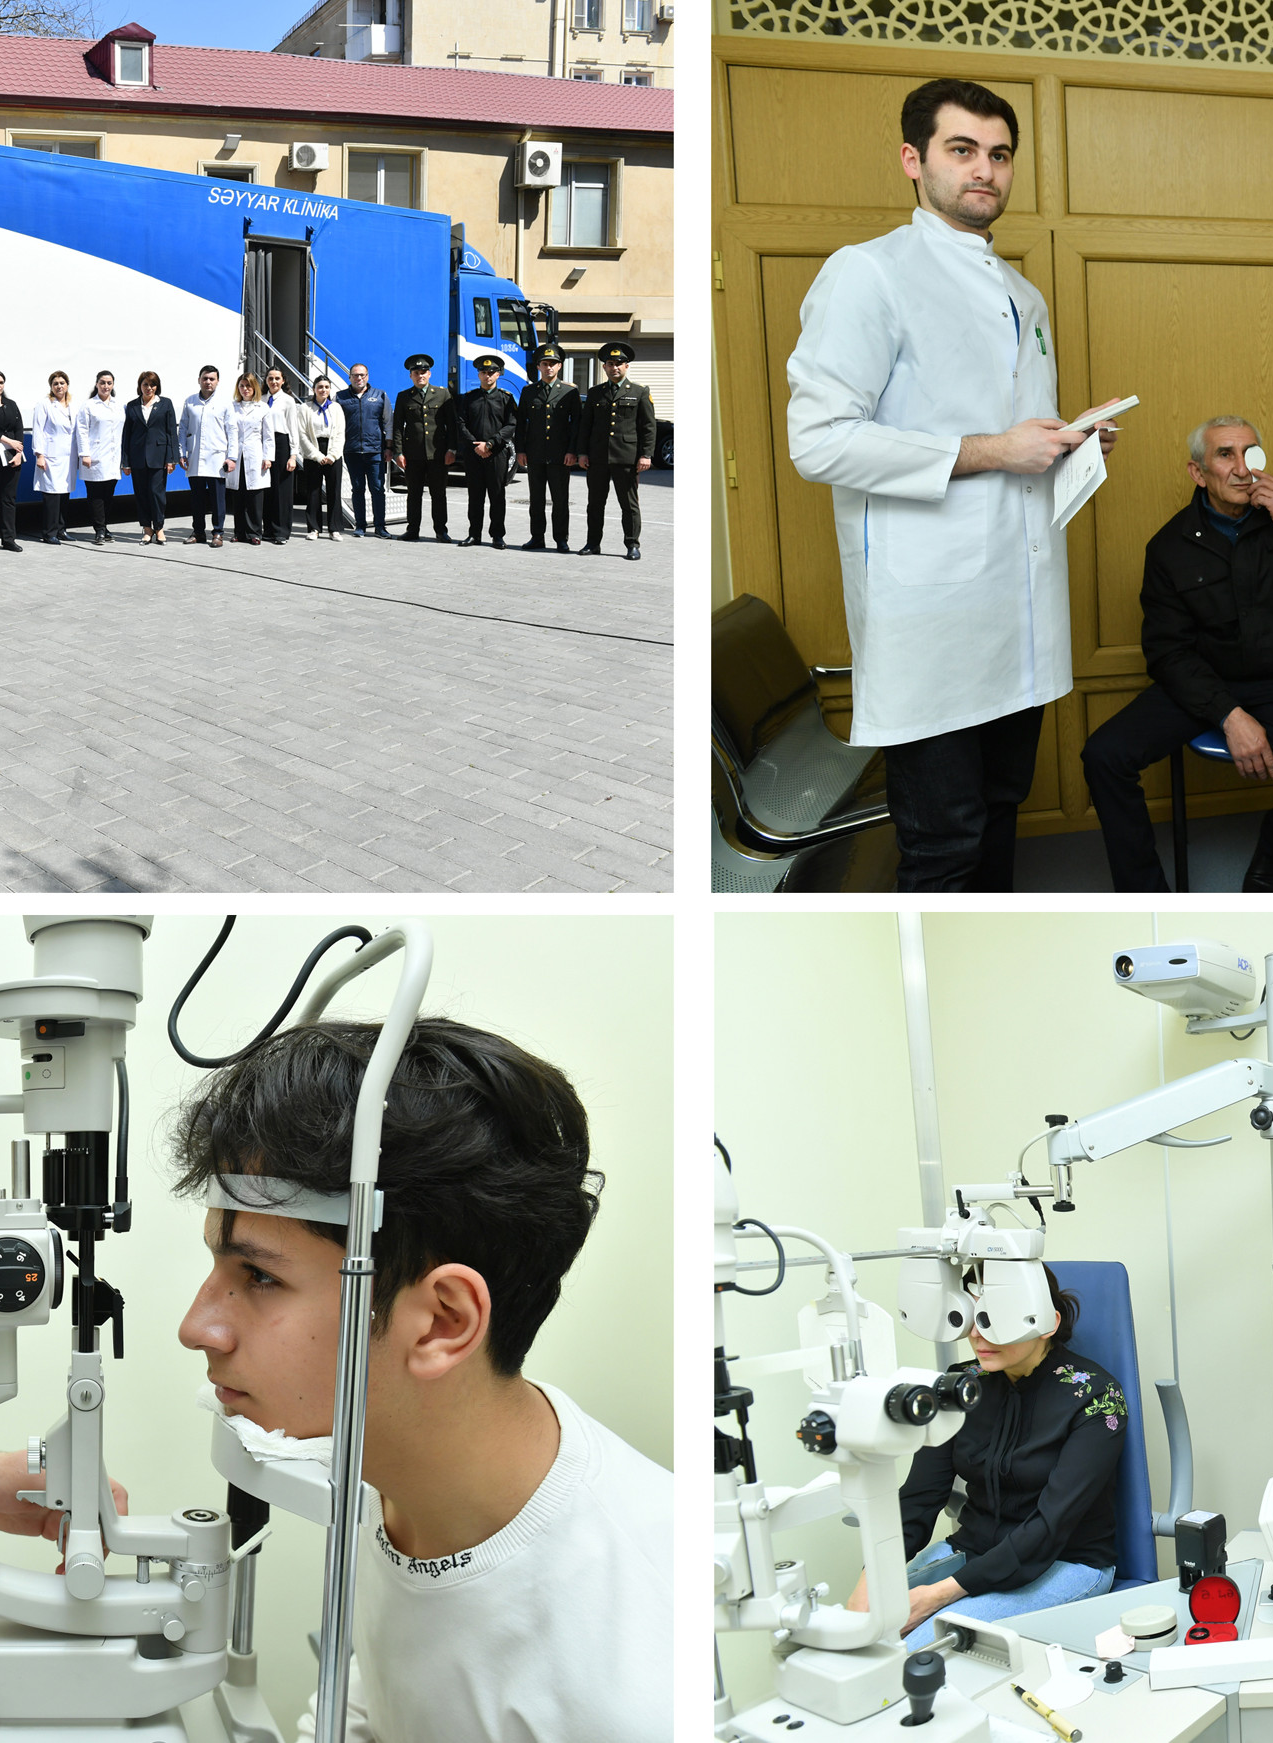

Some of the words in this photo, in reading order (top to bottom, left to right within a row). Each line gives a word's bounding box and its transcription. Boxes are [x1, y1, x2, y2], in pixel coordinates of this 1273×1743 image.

[207, 187, 280, 212] SƏYYAR
[282, 197, 339, 221] KLİNİKA
[16, 1251, 27, 1262] 16
[25, 1273, 38, 1282] 25
[15, 1290, 26, 1302] 40
[408, 1550, 472, 1578] Angels
